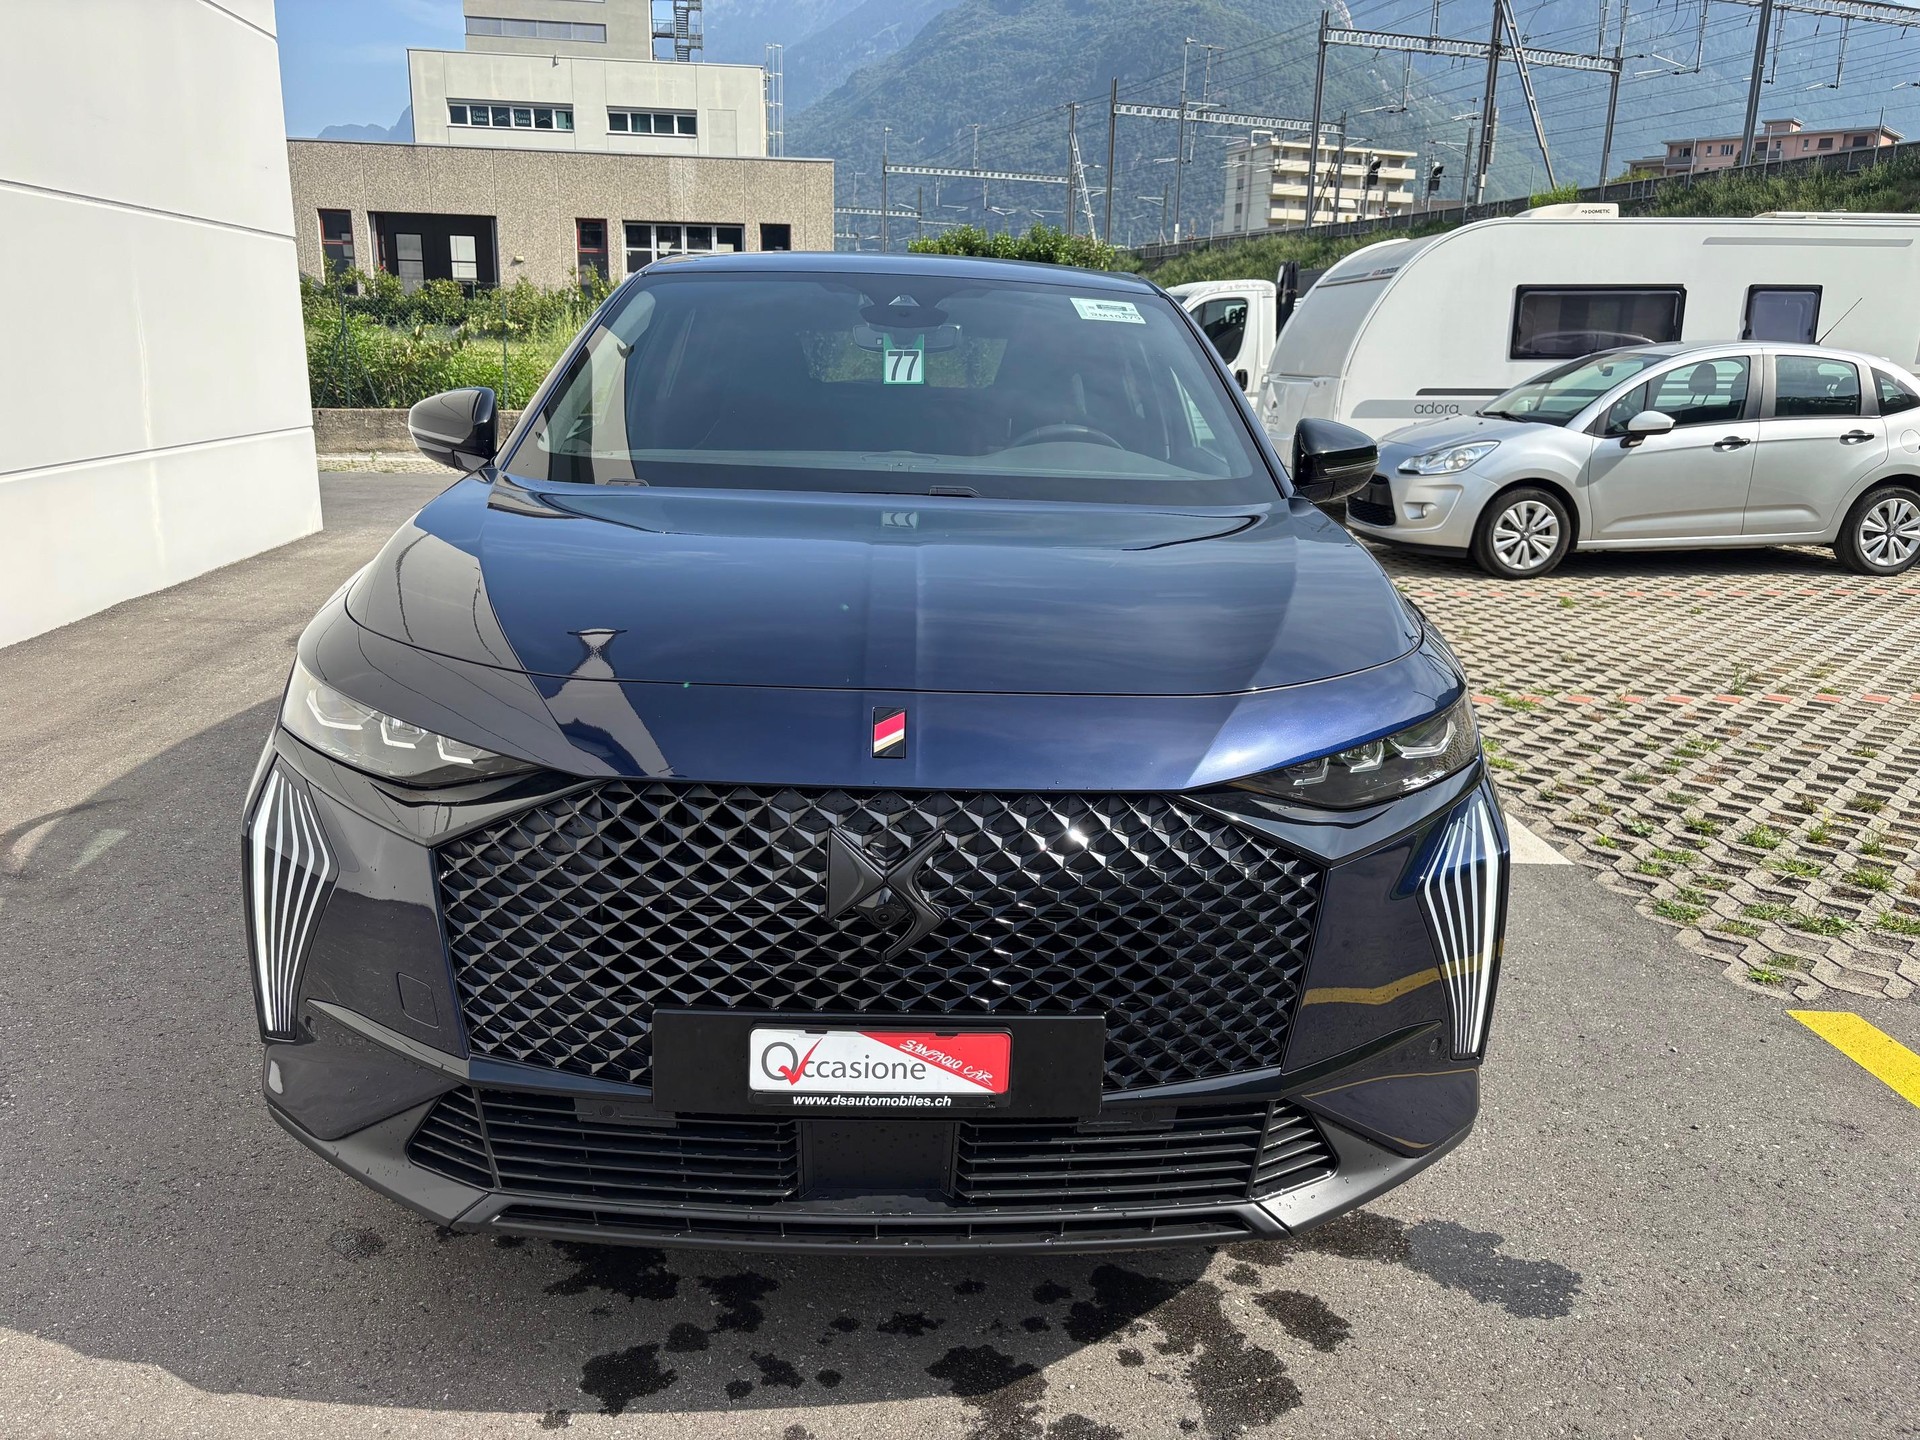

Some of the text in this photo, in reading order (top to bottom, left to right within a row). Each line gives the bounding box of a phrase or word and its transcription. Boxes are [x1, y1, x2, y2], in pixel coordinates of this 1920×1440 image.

[888, 350, 920, 381] 77
[1414, 402, 1459, 414] adora
[900, 1040, 993, 1086] SANPAOLO CAR
[793, 1095, 951, 1107] www.dsautomobiles.ch
